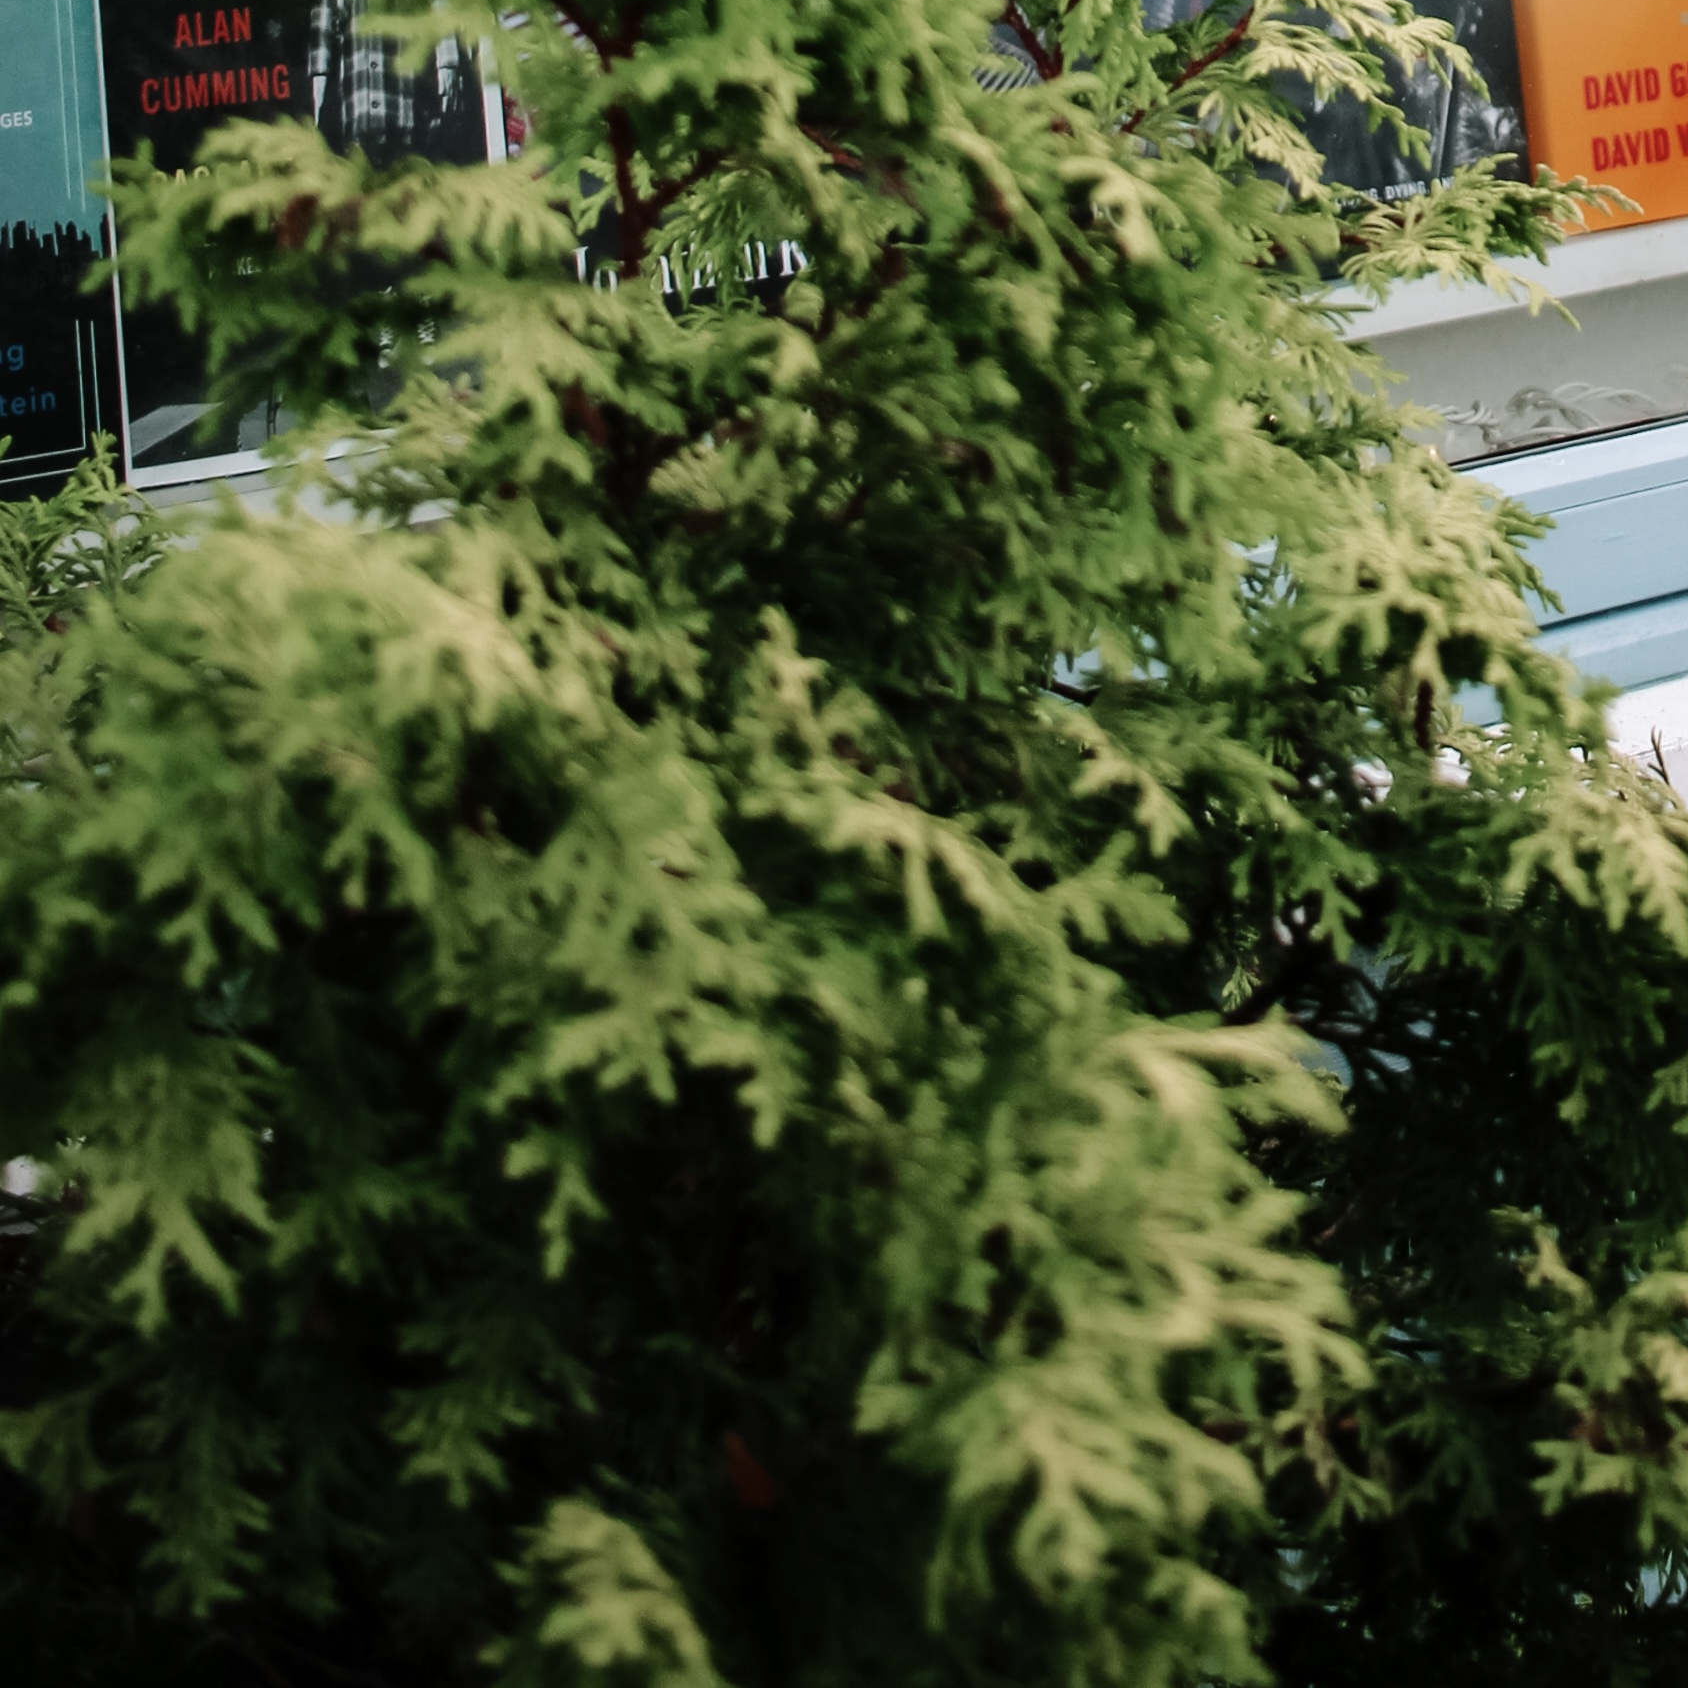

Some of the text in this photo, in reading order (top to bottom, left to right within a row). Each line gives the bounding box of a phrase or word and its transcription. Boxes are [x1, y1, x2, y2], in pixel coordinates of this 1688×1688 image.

[174, 6, 252, 49] ALAN
[140, 63, 291, 115] CUMMING
[1583, 66, 1661, 111] DAVID
[1592, 127, 1671, 172] DAVID
